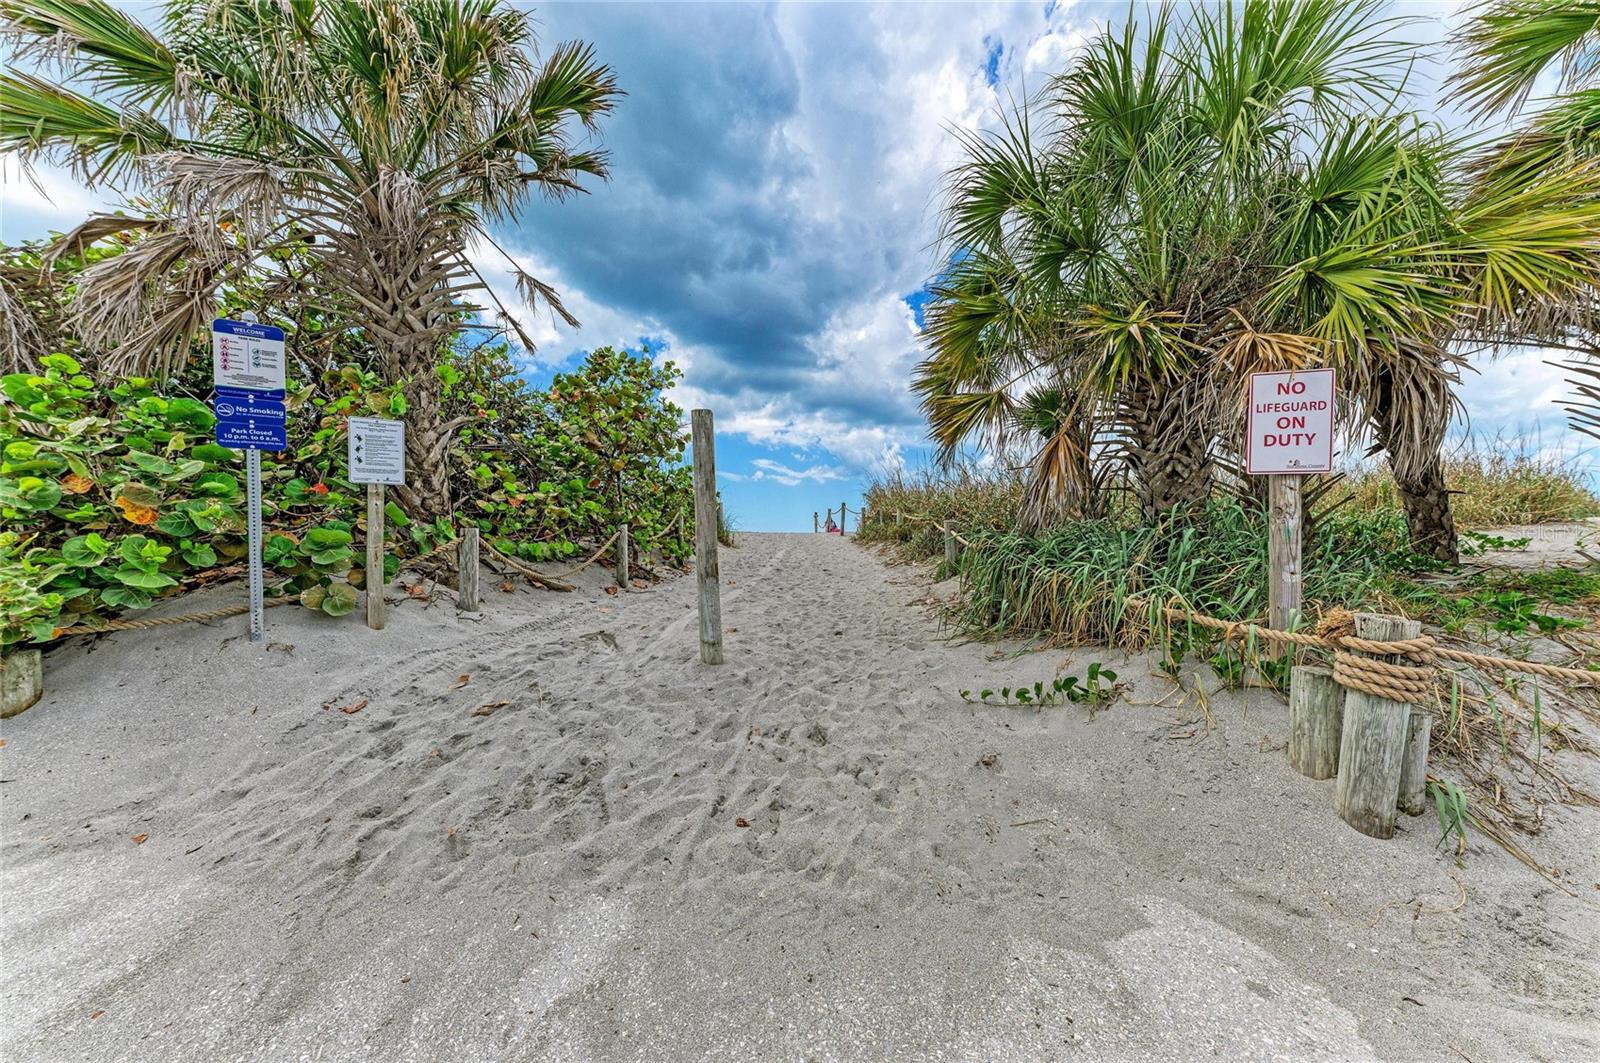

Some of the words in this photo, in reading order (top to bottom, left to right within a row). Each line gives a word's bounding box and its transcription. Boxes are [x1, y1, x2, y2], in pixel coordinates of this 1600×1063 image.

[232, 327, 265, 336] WELCOME
[1277, 382, 1306, 395] NO
[249, 407, 284, 416] Smoking
[1256, 401, 1327, 413] LIFEGUARD
[1276, 416, 1305, 429] ON
[1264, 433, 1316, 447] DUTY
